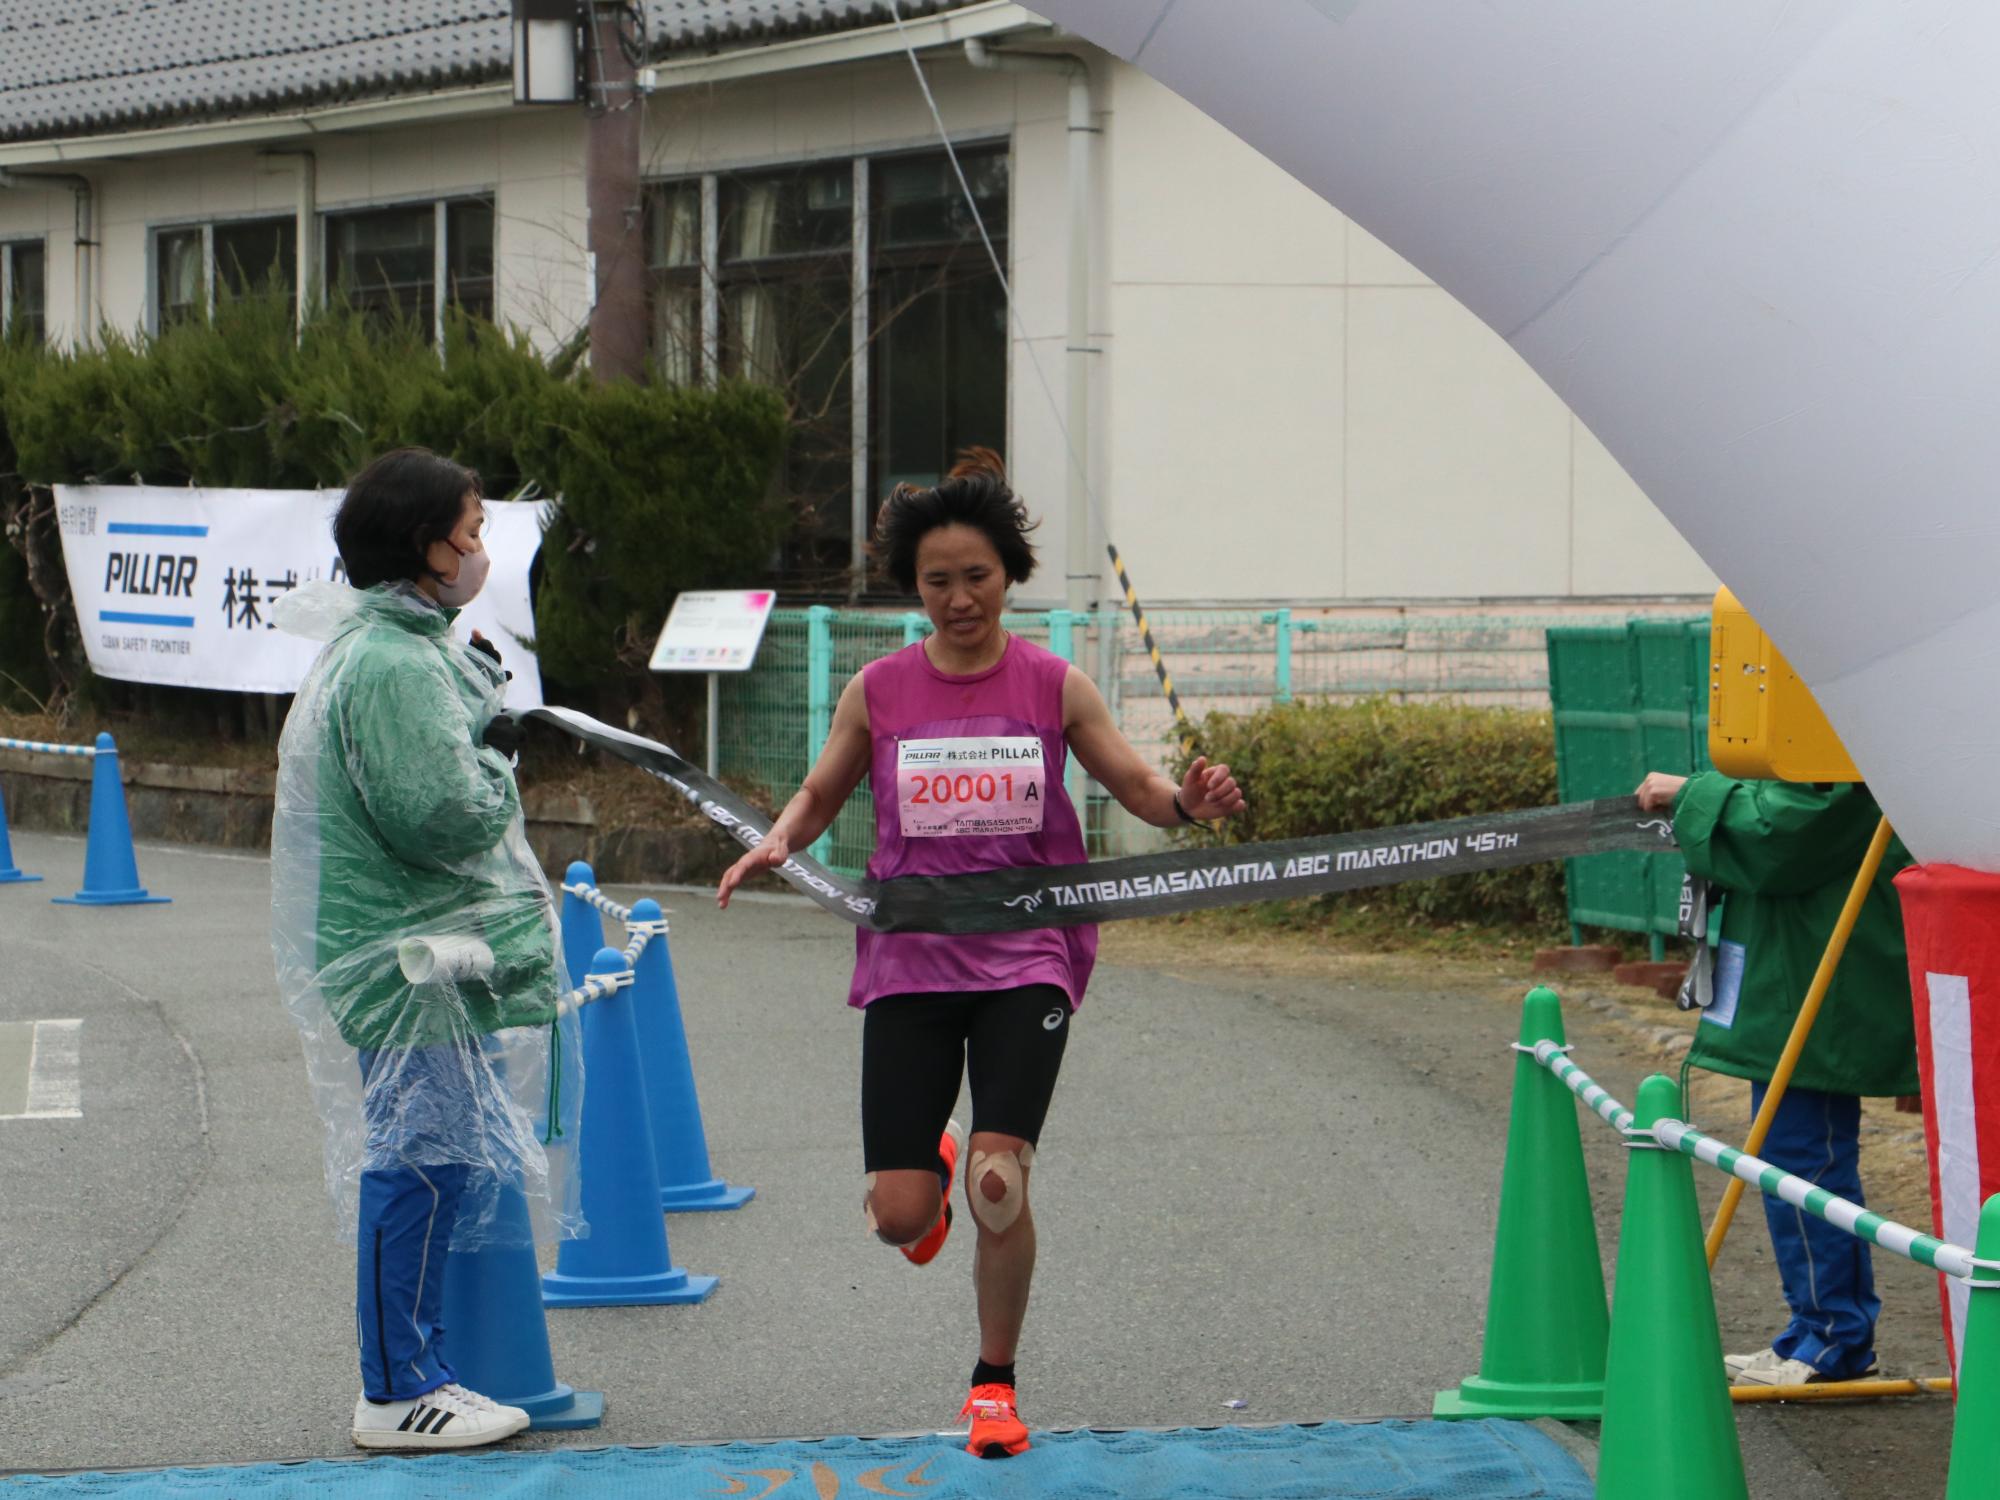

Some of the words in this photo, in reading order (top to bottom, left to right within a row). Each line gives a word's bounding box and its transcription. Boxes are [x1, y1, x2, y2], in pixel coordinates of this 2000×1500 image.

[104, 551, 199, 598] PILLAR
[122, 637, 149, 652] SAFETY
[151, 640, 192, 655] FRONTIER
[905, 751, 942, 761] PILLAR
[946, 749, 988, 761] 株式会社
[991, 747, 1040, 760] PILLAR
[910, 773, 1013, 804] 20001
[1024, 780, 1040, 802] A
[955, 817, 1033, 828] TAMBASASAYAMA
[955, 827, 971, 835] ABC
[972, 825, 1014, 834] MARATHON
[1049, 861, 1277, 906] TAMBASASAYAMA
[1283, 855, 1330, 879] ABC
[1336, 837, 1459, 872] MARATHON
[1465, 832, 1519, 852] 45TH
